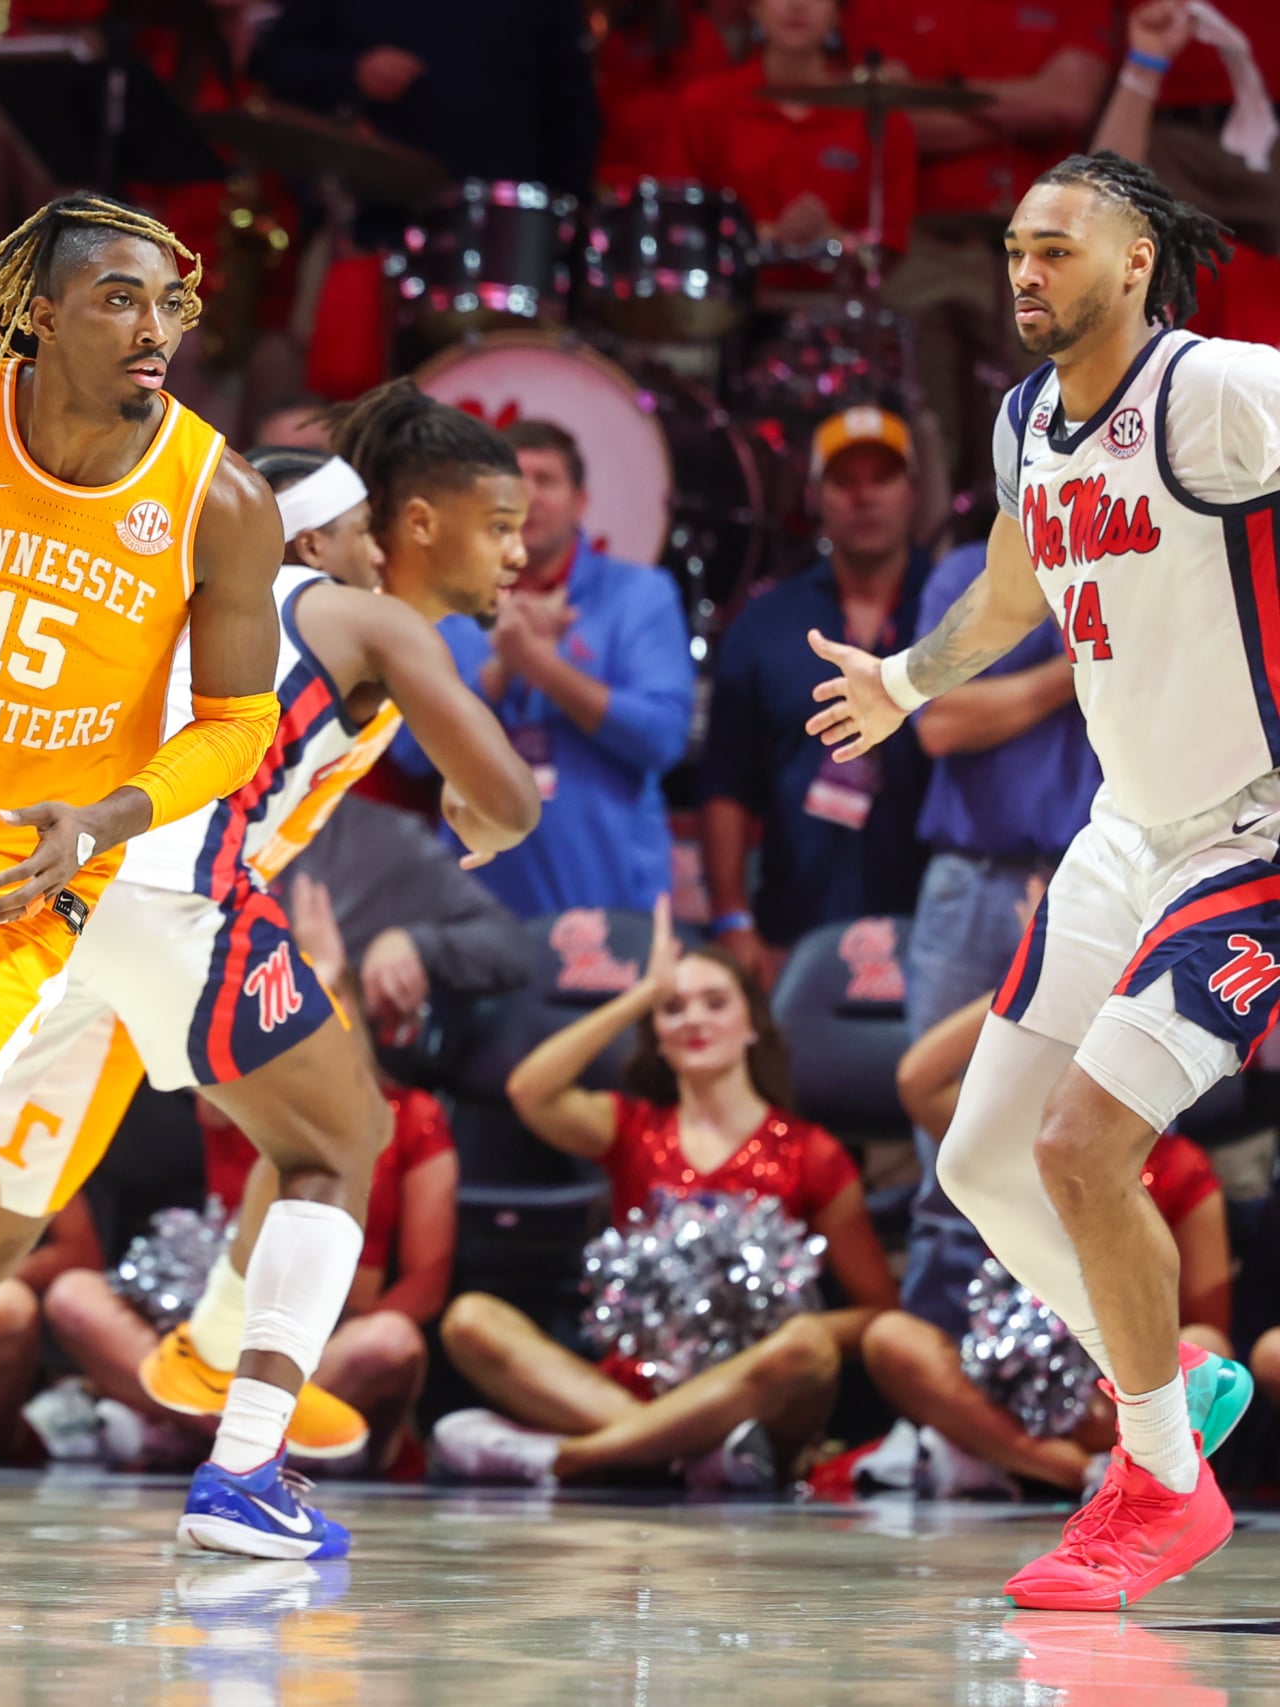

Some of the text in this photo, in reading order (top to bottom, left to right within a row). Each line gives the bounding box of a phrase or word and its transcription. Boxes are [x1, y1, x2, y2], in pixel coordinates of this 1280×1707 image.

[1111, 409, 1141, 446] SEC
[128, 502, 168, 542] SEC
[1022, 473, 1161, 571] Ole Miss
[1063, 581, 1113, 664] 14
